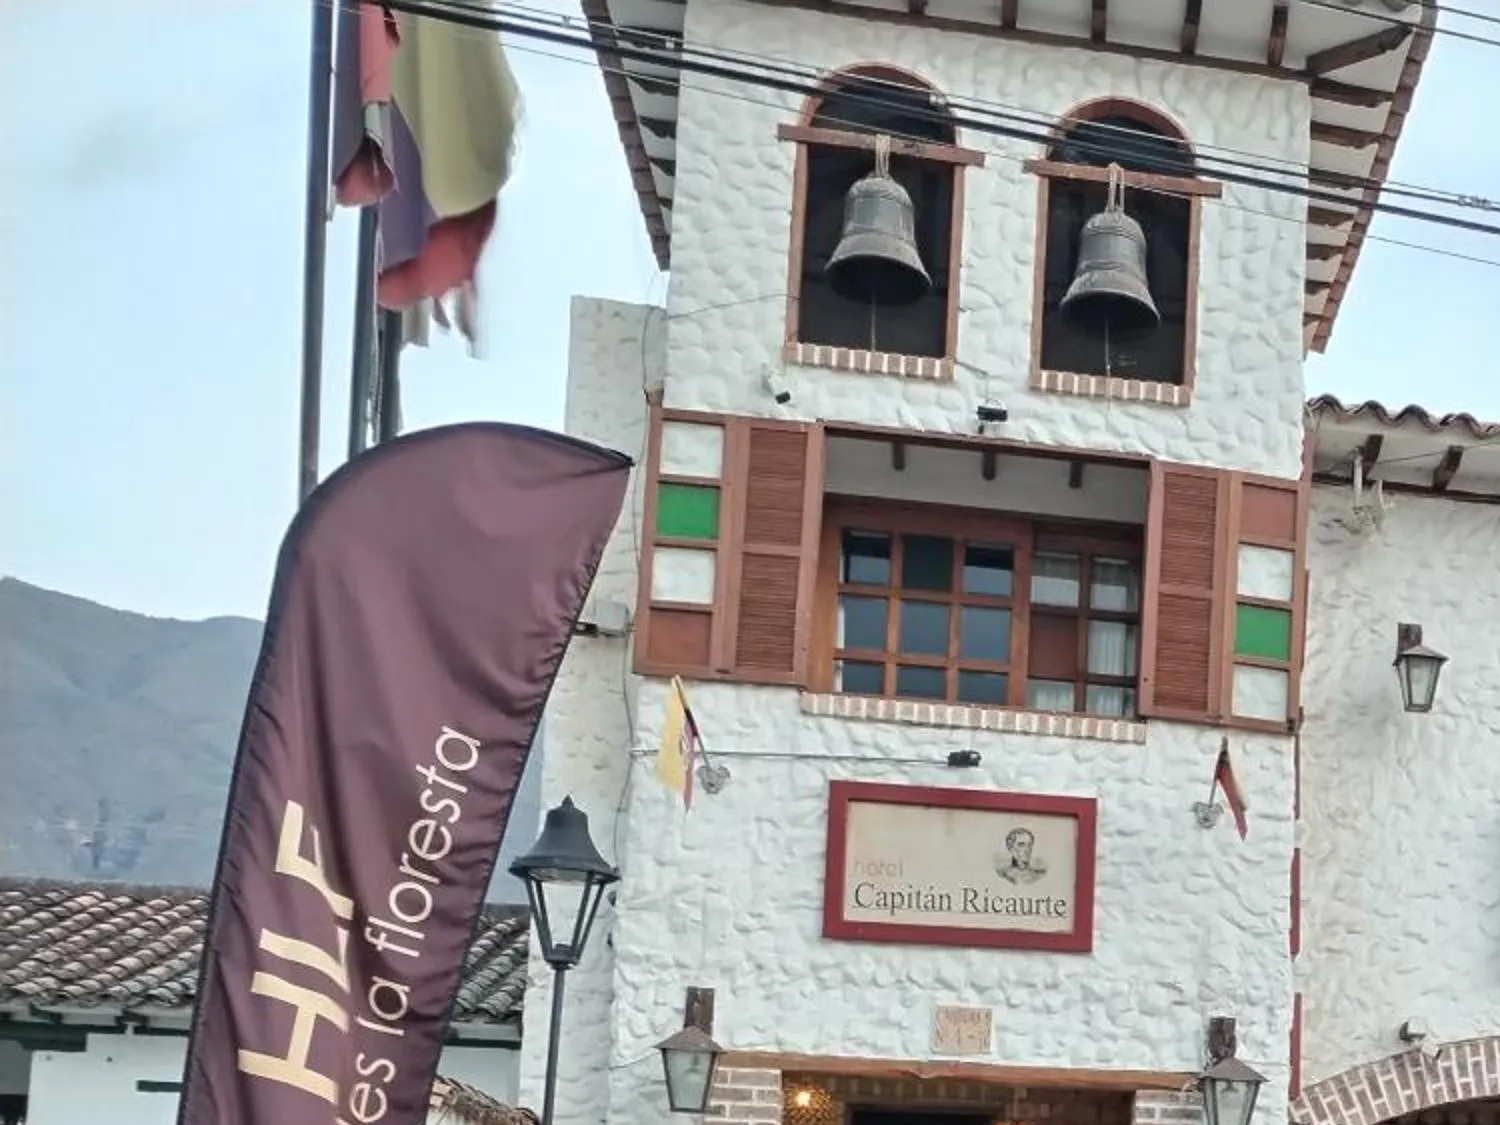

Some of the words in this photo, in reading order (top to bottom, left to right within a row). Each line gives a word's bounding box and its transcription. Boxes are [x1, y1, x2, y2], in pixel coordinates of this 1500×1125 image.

[364, 724, 482, 958] floresta
[854, 882, 952, 916] Capitán
[961, 887, 1068, 917] Ricaurte
[237, 799, 354, 1104] HLF
[358, 975, 411, 1036] la
